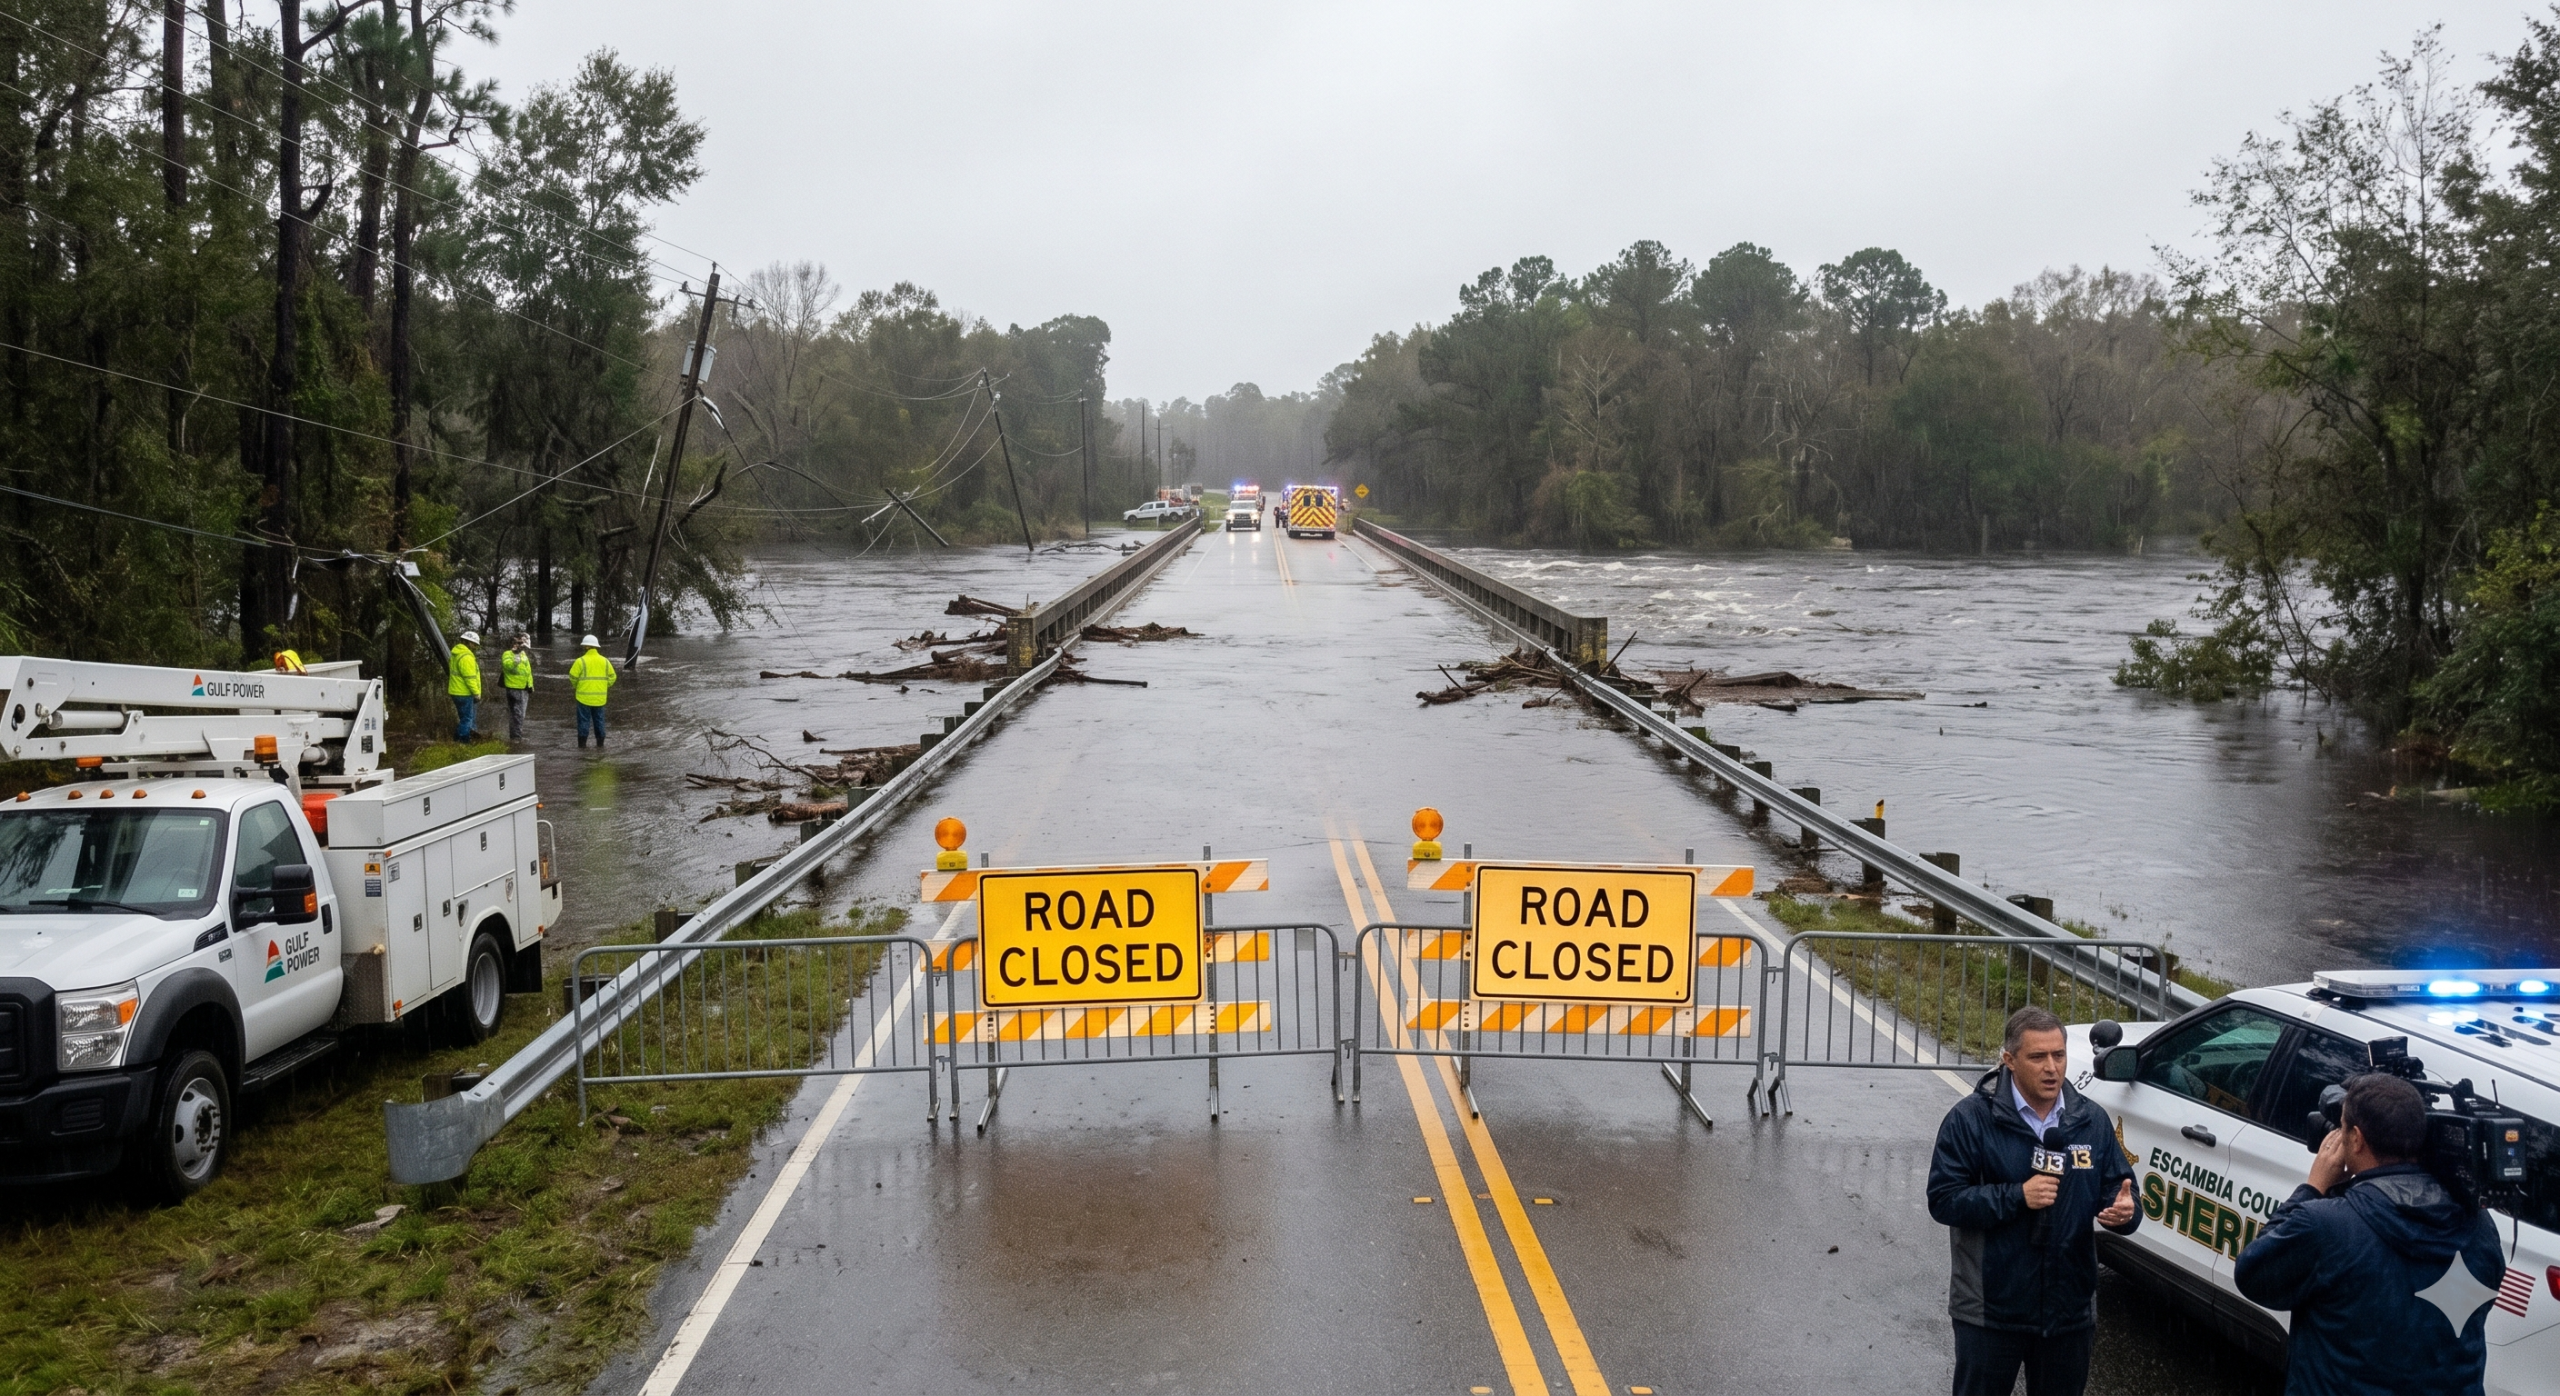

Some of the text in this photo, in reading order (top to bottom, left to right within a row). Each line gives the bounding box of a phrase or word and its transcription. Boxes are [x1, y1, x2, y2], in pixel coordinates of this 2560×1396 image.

[207, 681, 265, 699] GULF POWER
[1024, 888, 1155, 932] ROAD
[1520, 885, 1650, 928] ROAD
[285, 931, 309, 955] GULF
[287, 946, 320, 974] POWER
[999, 942, 1184, 987] CLOSED
[1491, 939, 1674, 983] CLOSED
[2033, 1151, 2065, 1172] 13 13
[2071, 1150, 2092, 1168] 13
[2149, 1146, 2281, 1220] ESCAMBIA COU
[2140, 1171, 2267, 1262] SHERI
